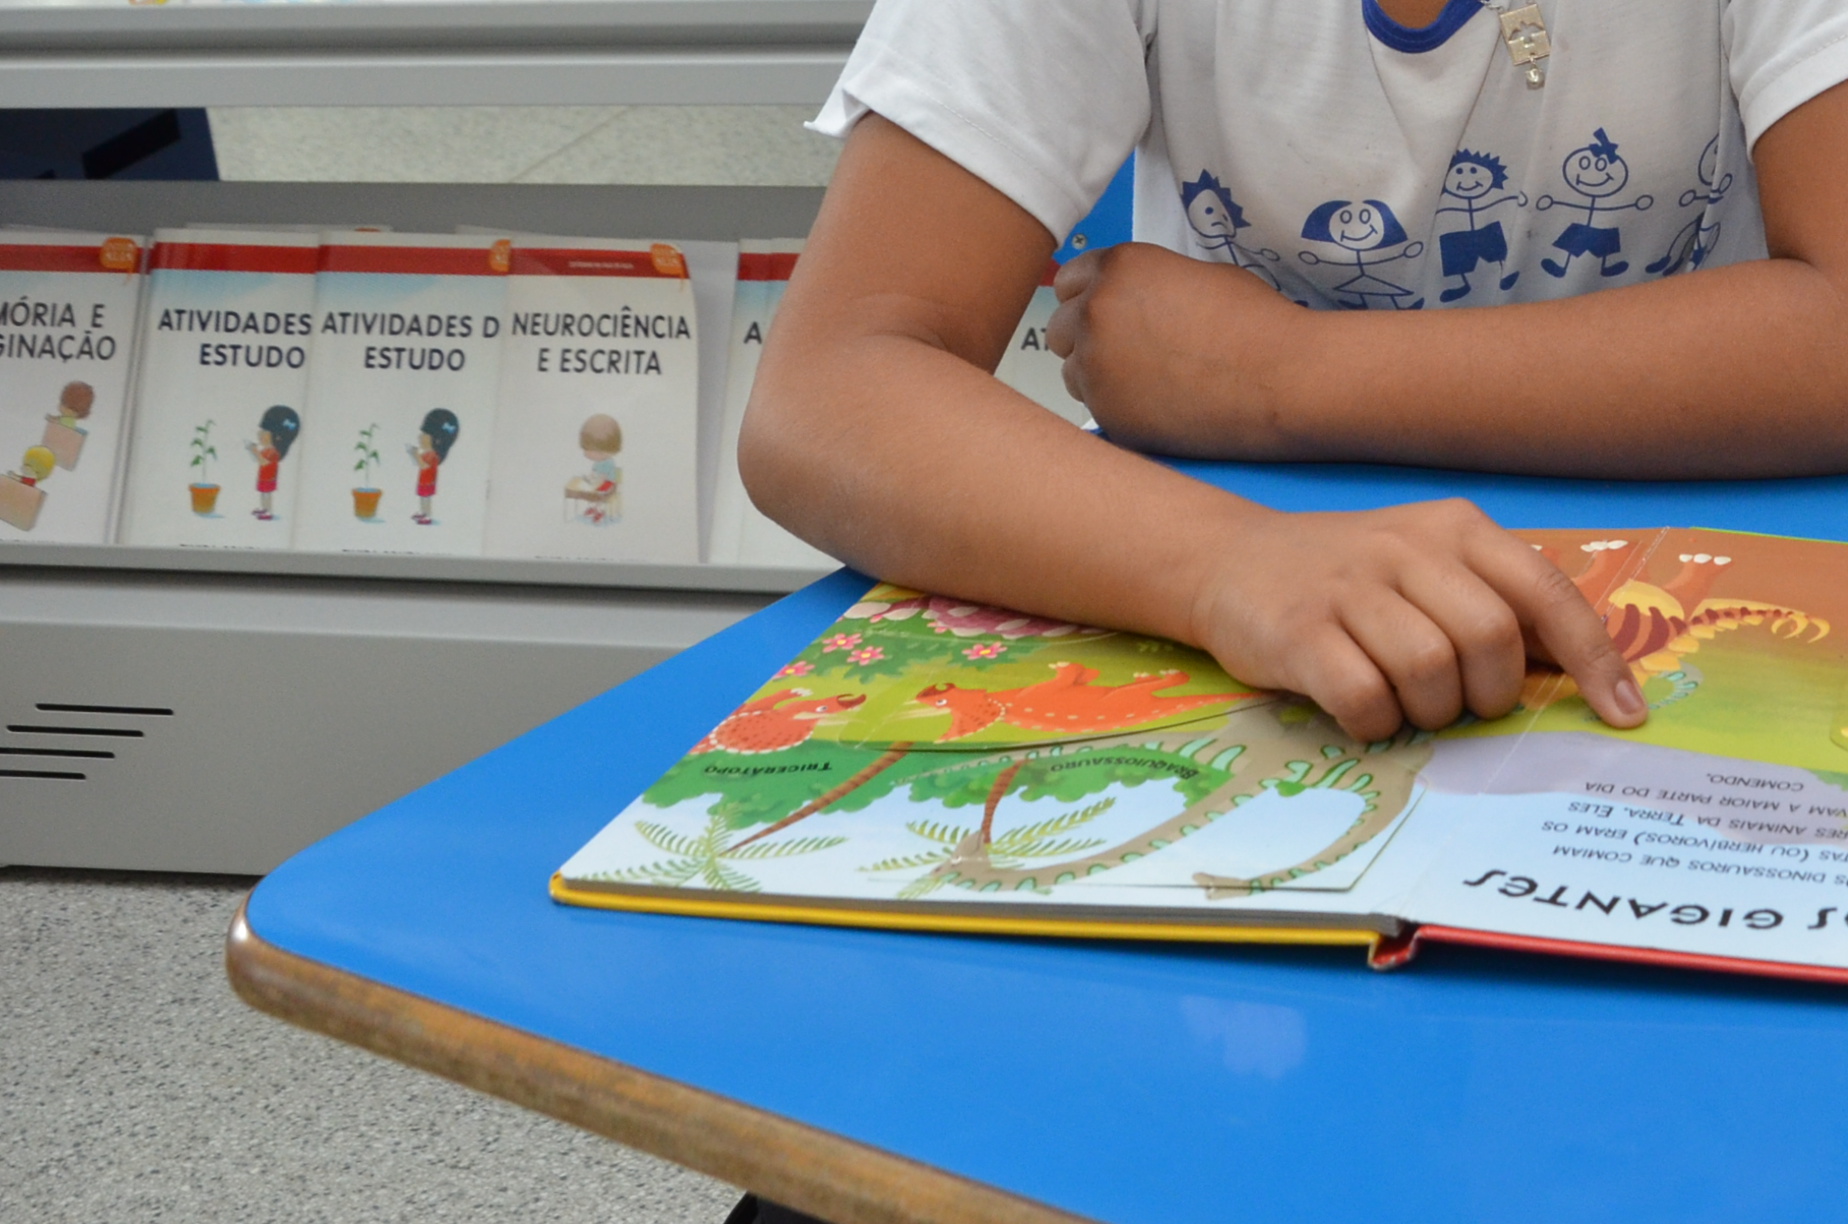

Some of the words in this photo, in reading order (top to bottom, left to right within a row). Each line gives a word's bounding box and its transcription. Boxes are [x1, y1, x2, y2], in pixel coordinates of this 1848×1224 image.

[92, 303, 105, 328] E
[158, 308, 313, 336] ATIVIDADES
[321, 311, 473, 338] ATIVIDADES
[511, 306, 691, 339] NEUROCIÊNCIA
[199, 343, 306, 369] ESTUDO
[364, 346, 466, 371] ESTUDO
[537, 348, 550, 372] E
[559, 348, 662, 375] ESCRITA
[704, 761, 833, 776] TRICERATOPO
[1050, 756, 1198, 780] BRAQUIOSSAURO
[1584, 781, 1614, 794] DIA
[1621, 785, 1649, 797] DO
[1706, 772, 1804, 792] COMENDO.
[1657, 788, 1712, 805] PARTE
[1719, 795, 1780, 811] MAIOR
[1788, 802, 1801, 813] A
[1541, 820, 1568, 833] OS
[1697, 815, 1722, 827] DA
[1730, 819, 1806, 836] ANIMAIS
[1575, 825, 1628, 840] ERAM
[1633, 831, 1763, 856] HERBÍVOROS)
[1553, 845, 1633, 864] COMIAM
[1641, 855, 1680, 869] QUE
[1772, 845, 1809, 864] (OU
[1687, 858, 1826, 884] DINOSSAUROS
[1463, 869, 1784, 930] GIGANTES
